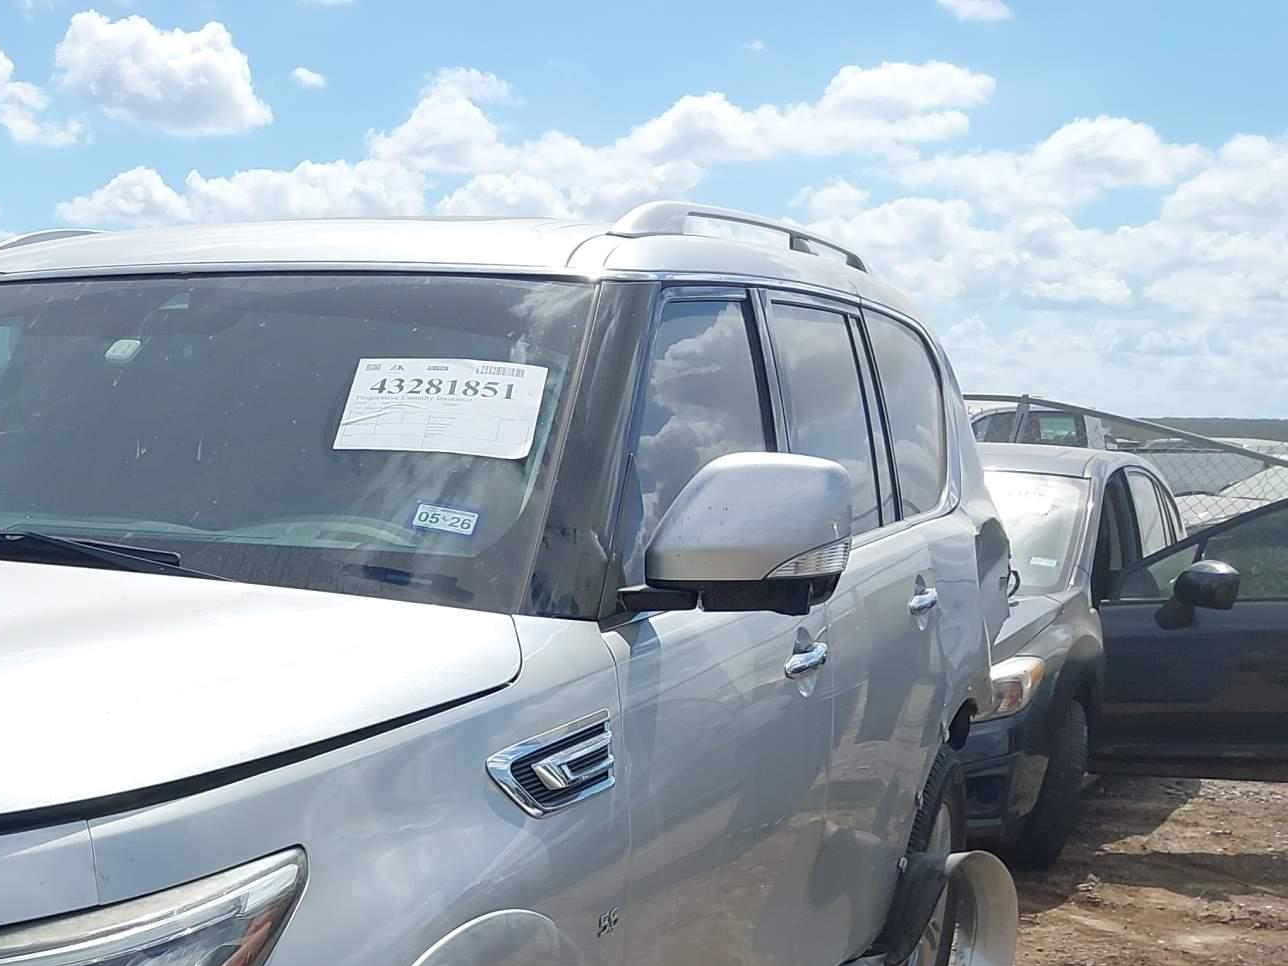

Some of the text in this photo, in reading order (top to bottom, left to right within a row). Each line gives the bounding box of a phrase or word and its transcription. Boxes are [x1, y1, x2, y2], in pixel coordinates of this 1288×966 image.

[369, 378, 515, 400] 43281851
[418, 511, 441, 525] 05
[448, 516, 472, 530] 26
